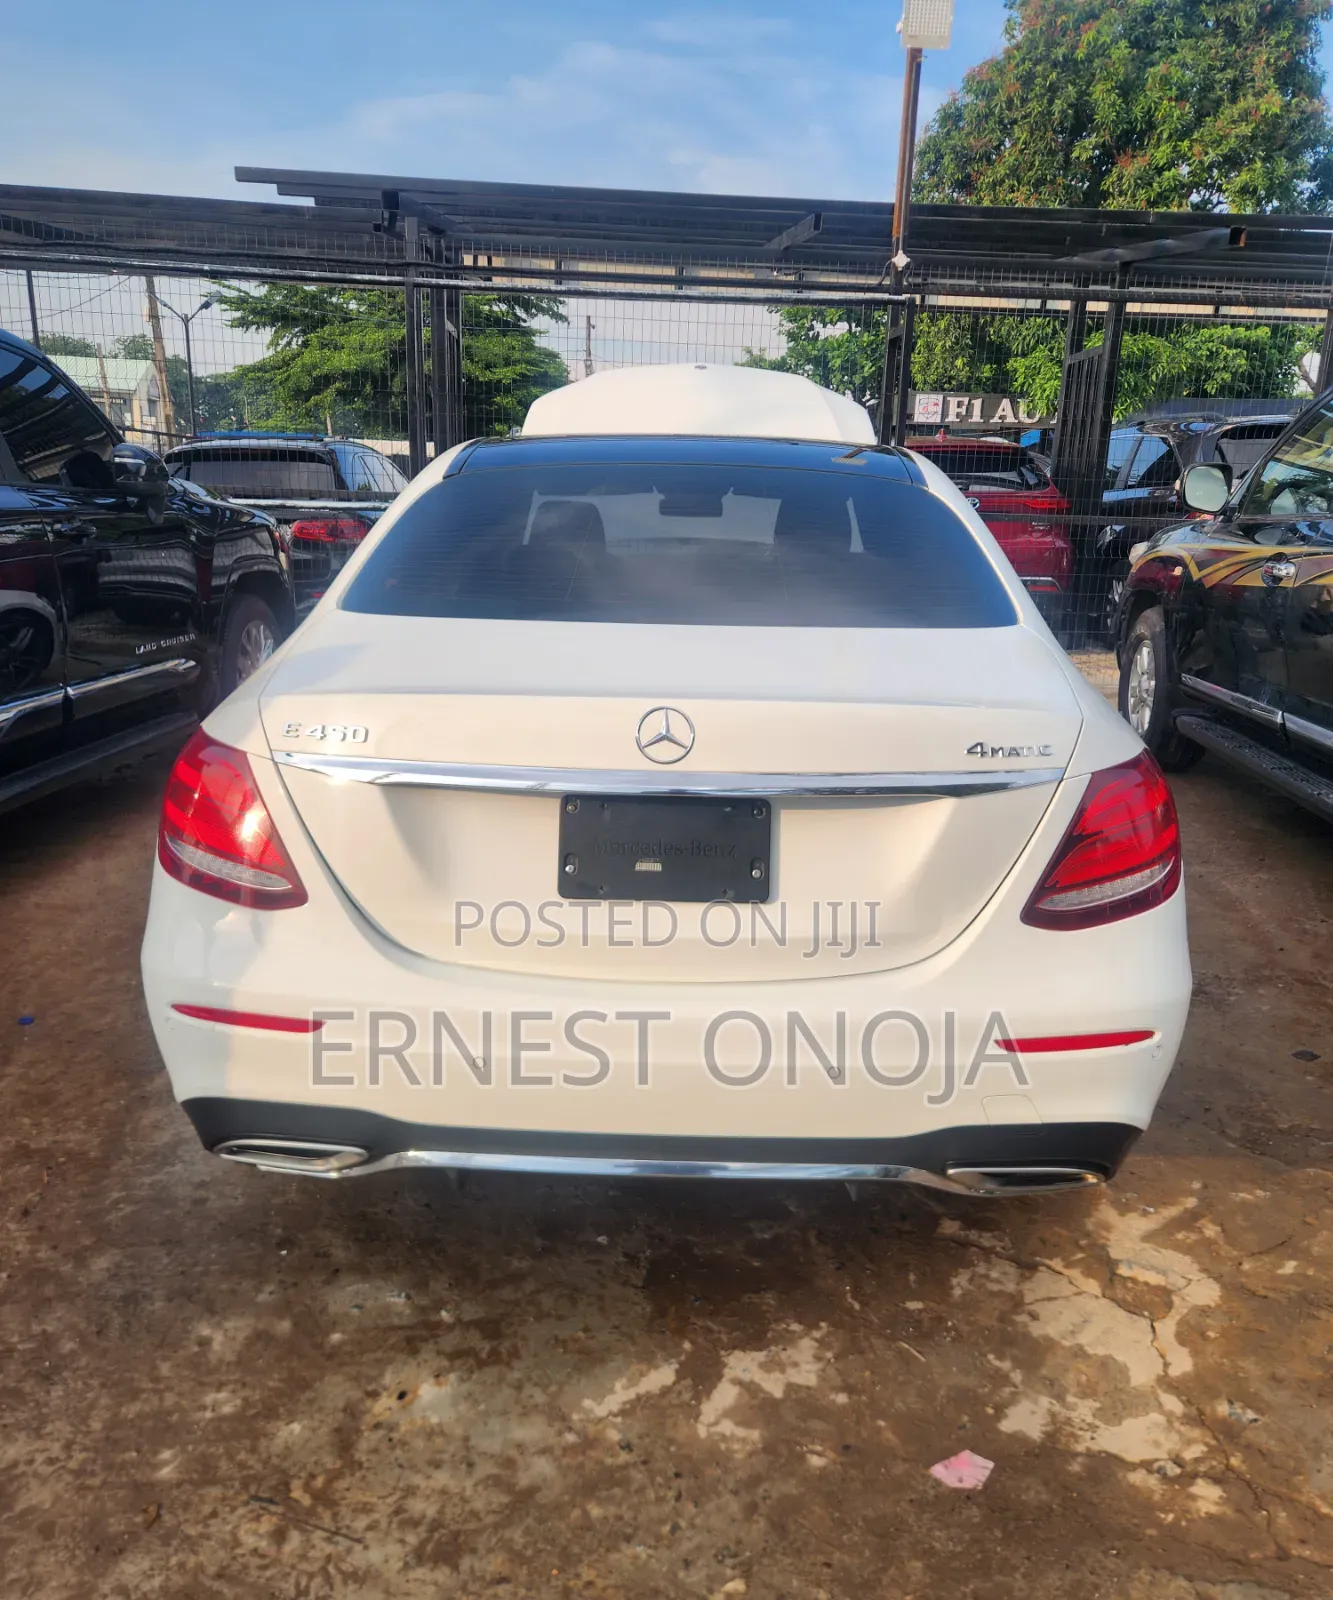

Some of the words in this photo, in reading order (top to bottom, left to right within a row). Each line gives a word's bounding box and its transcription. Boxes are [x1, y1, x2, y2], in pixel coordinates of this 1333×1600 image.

[945, 396, 984, 423] F1
[135, 642, 157, 655] LAND
[160, 633, 196, 647] CRUISER
[282, 721, 302, 738] E
[304, 724, 369, 744] 450
[963, 741, 1053, 758] 4MATIC
[592, 837, 738, 860] Mercedes-Benz
